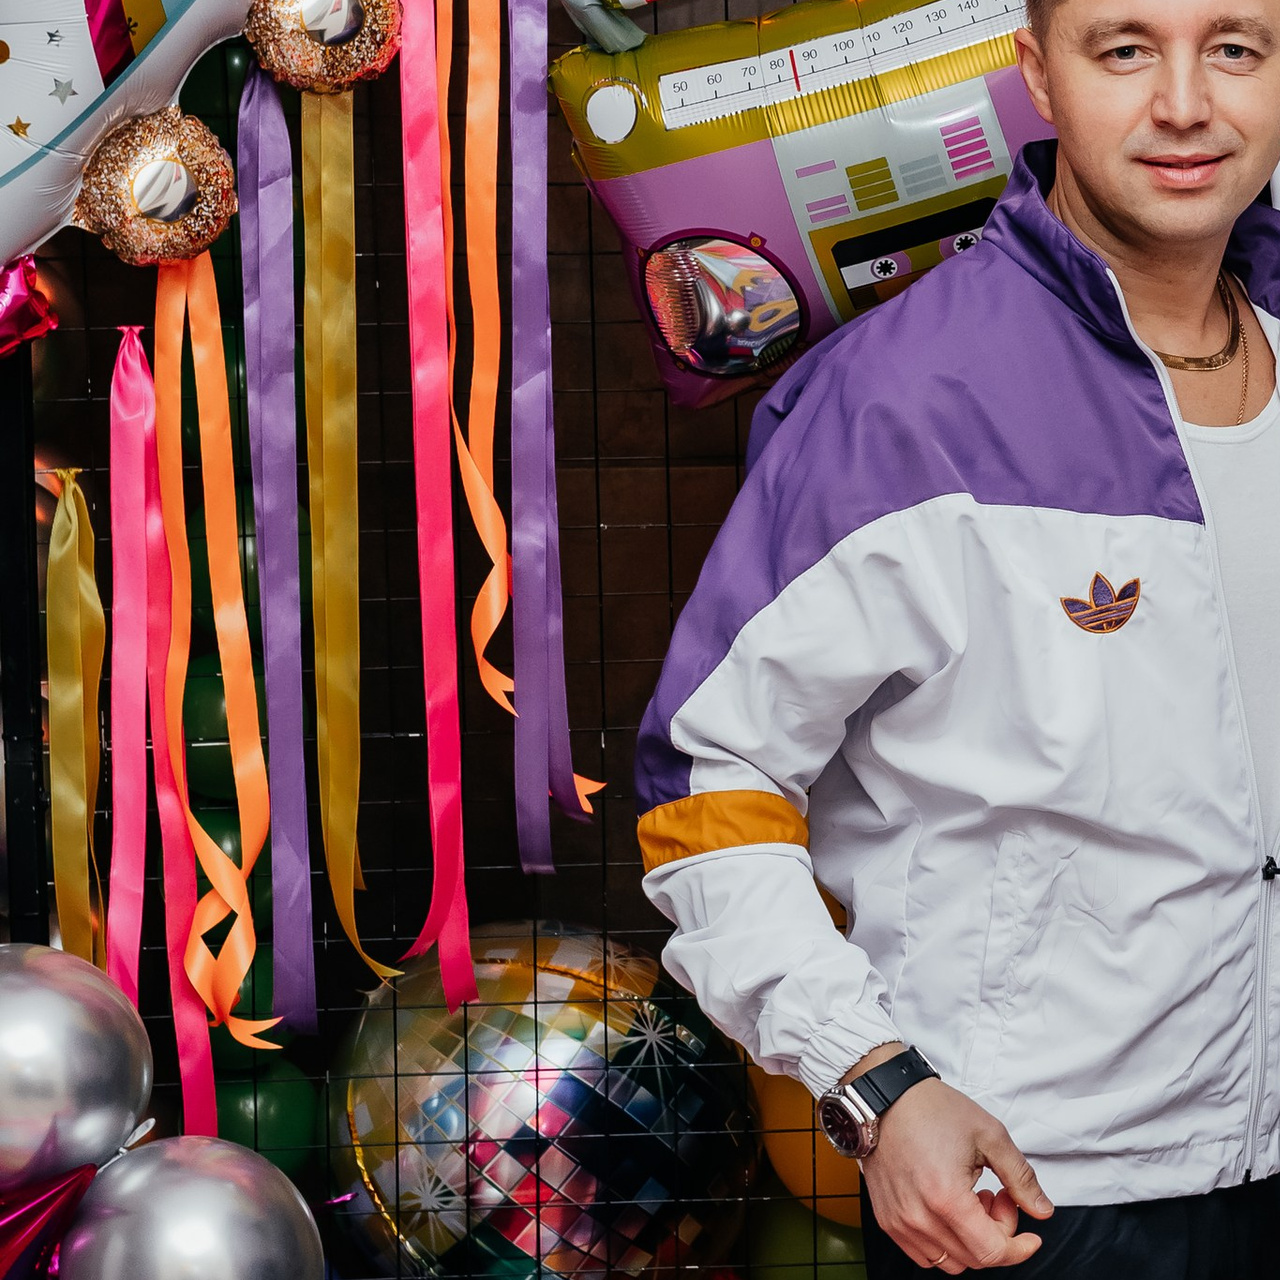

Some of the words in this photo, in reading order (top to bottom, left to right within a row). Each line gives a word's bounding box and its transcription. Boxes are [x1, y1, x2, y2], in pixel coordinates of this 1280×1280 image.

[673, 81, 688, 93] 50
[706, 73, 722, 85] 60
[741, 65, 757, 78] 70
[769, 57, 785, 70] 80
[802, 48, 818, 61] 90
[832, 39, 854, 52] 100
[892, 19, 914, 35] 120
[925, 9, 947, 24] 130
